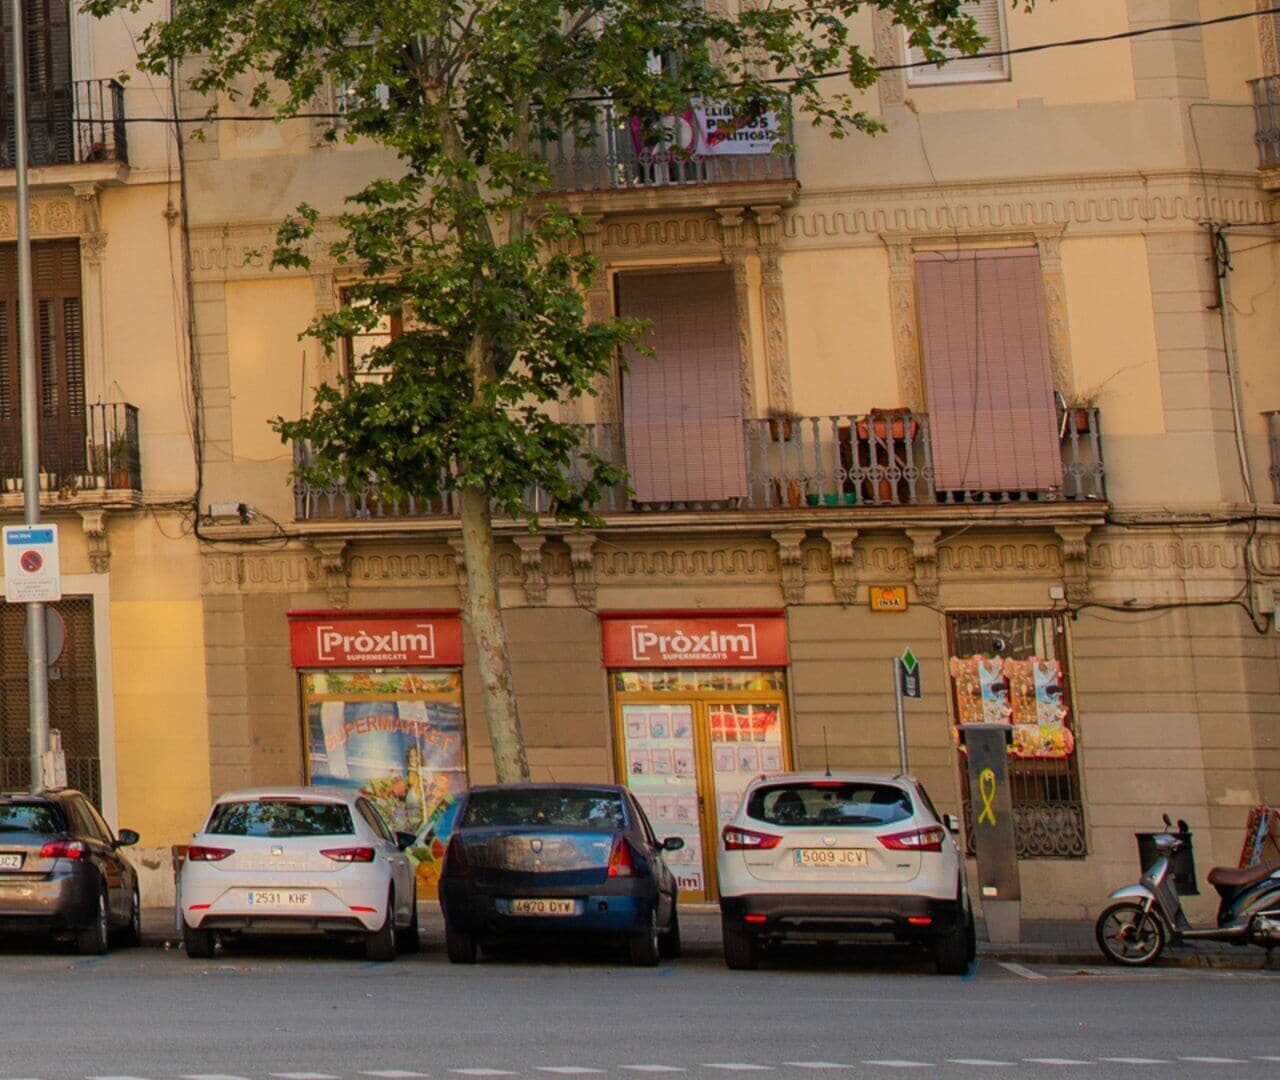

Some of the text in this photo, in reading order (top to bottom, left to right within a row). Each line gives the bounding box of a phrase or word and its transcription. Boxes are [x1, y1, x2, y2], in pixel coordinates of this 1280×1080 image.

[346, 653, 408, 661] SUPERMERCATS
[662, 653, 728, 661] SUPERMERCATS
[326, 714, 453, 751] SUPERMARKET
[0, 856, 19, 867] JCZ
[803, 851, 862, 862] 5009 JCV
[255, 892, 309, 904] 2531 KHF
